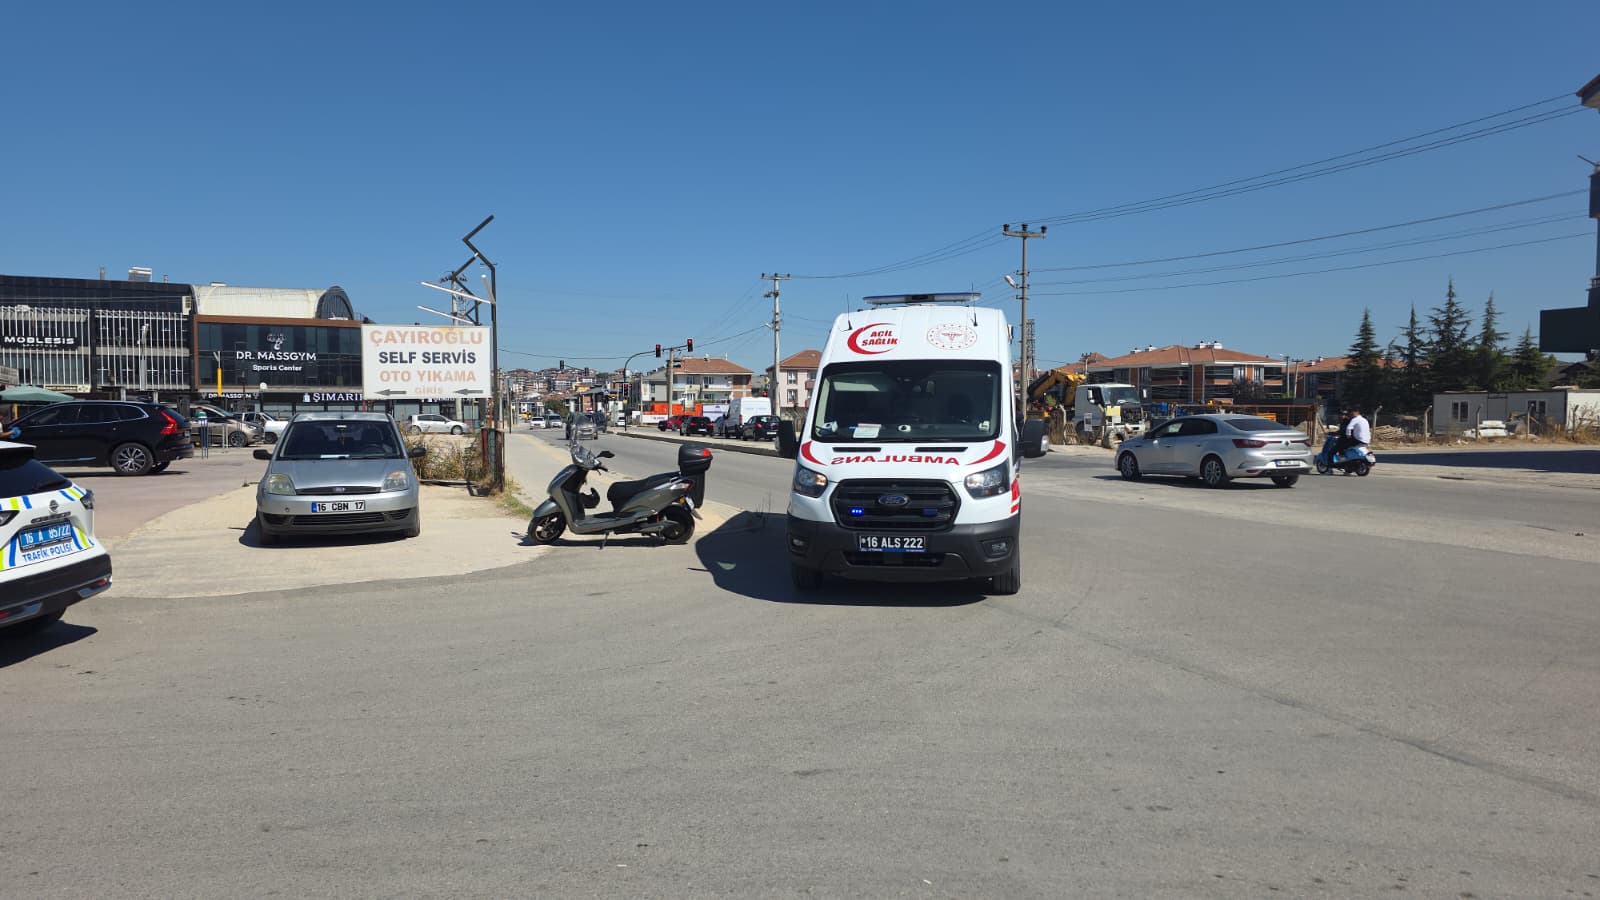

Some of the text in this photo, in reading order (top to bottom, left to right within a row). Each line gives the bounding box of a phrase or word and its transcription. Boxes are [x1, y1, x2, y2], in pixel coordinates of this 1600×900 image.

[369, 327, 483, 347] ÇAYIROĞLU
[861, 338, 898, 347] SAĞLIK
[236, 351, 317, 361] DR. MASSGYM
[378, 348, 476, 364] SELF SERVİS
[252, 364, 303, 372] Sports Center
[379, 370, 476, 382] OTO YIKAMA
[317, 501, 364, 512] 16 CBN 17
[38, 529, 44, 542] A
[867, 536, 924, 549] 16 ALS 222
[22, 547, 49, 563] TRAFİK
